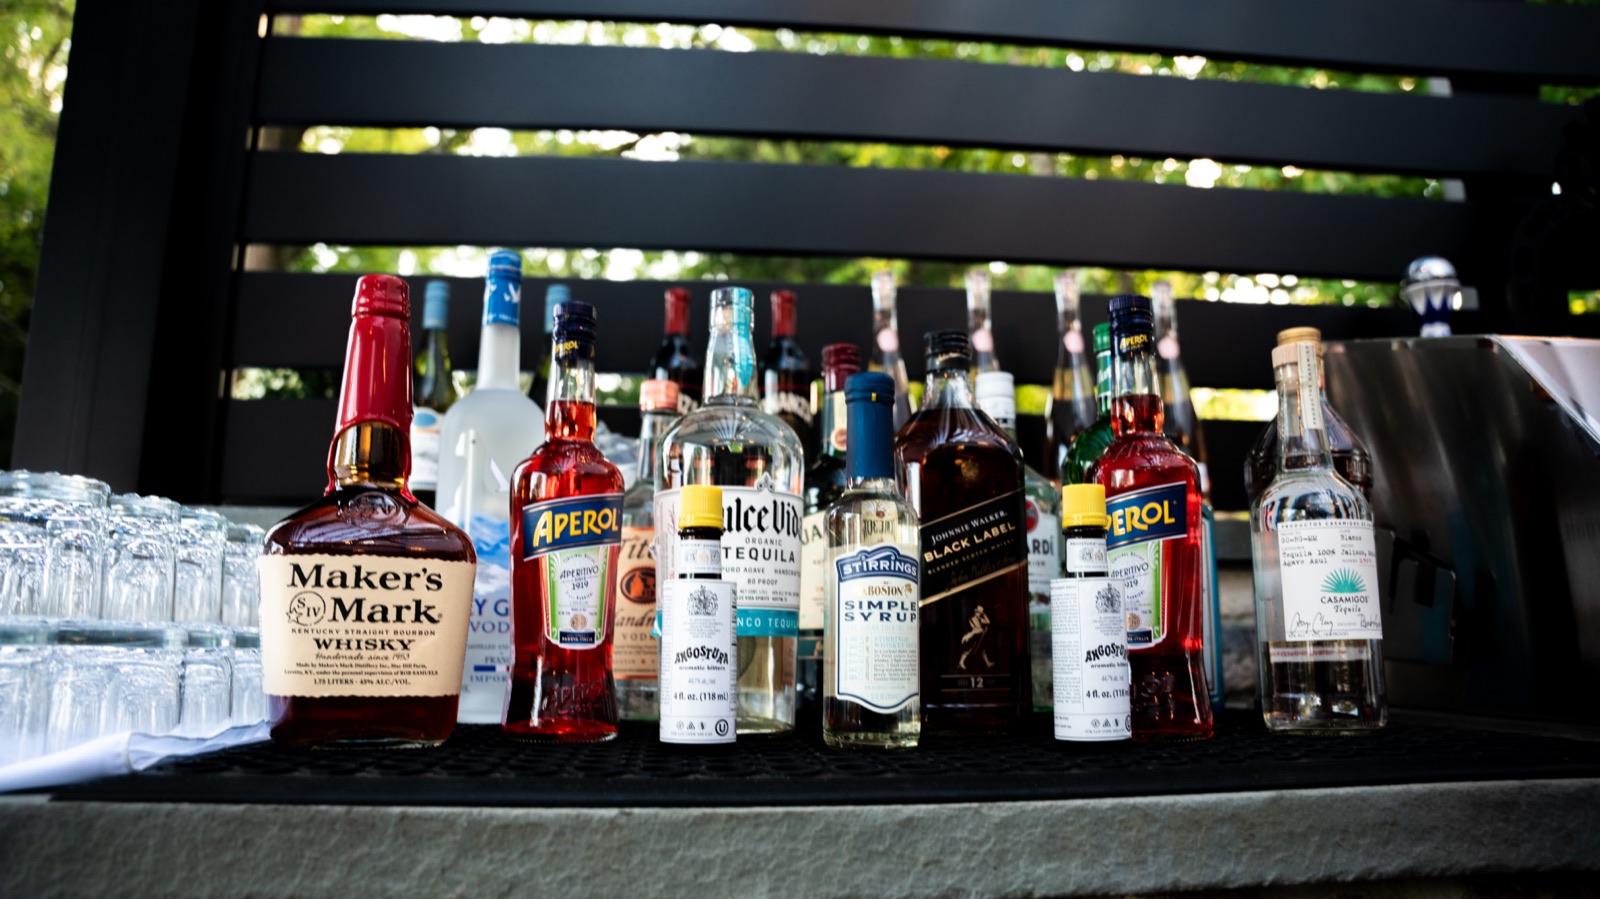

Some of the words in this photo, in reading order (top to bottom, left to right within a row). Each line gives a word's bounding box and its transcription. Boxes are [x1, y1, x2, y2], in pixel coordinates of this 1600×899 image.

[721, 497, 769, 536] ulce
[1104, 500, 1176, 537] EROL
[532, 507, 619, 548] APEROL
[931, 523, 970, 546] JOHNNIE
[745, 537, 782, 547] ORGANIC
[924, 537, 971, 563] BLACK
[973, 522, 1016, 544] LABEL
[722, 546, 795, 563] TEQUILA
[1282, 551, 1312, 559] Tequila
[1317, 548, 1335, 557] 100%
[286, 563, 443, 592] Maker's
[560, 565, 599, 579] APERITIVO
[572, 581, 589, 591] 1919
[1124, 579, 1138, 589] 919
[844, 601, 917, 611] SIMPLE
[1320, 596, 1369, 604] CASAMIGOS
[328, 597, 441, 624] Mark
[844, 612, 917, 622] SYRUP
[313, 637, 416, 651] WHISKY
[315, 652, 364, 660] Handmade
[674, 645, 729, 665] ANGOSTURA
[970, 676, 984, 688] 12
[699, 691, 716, 702] (118
